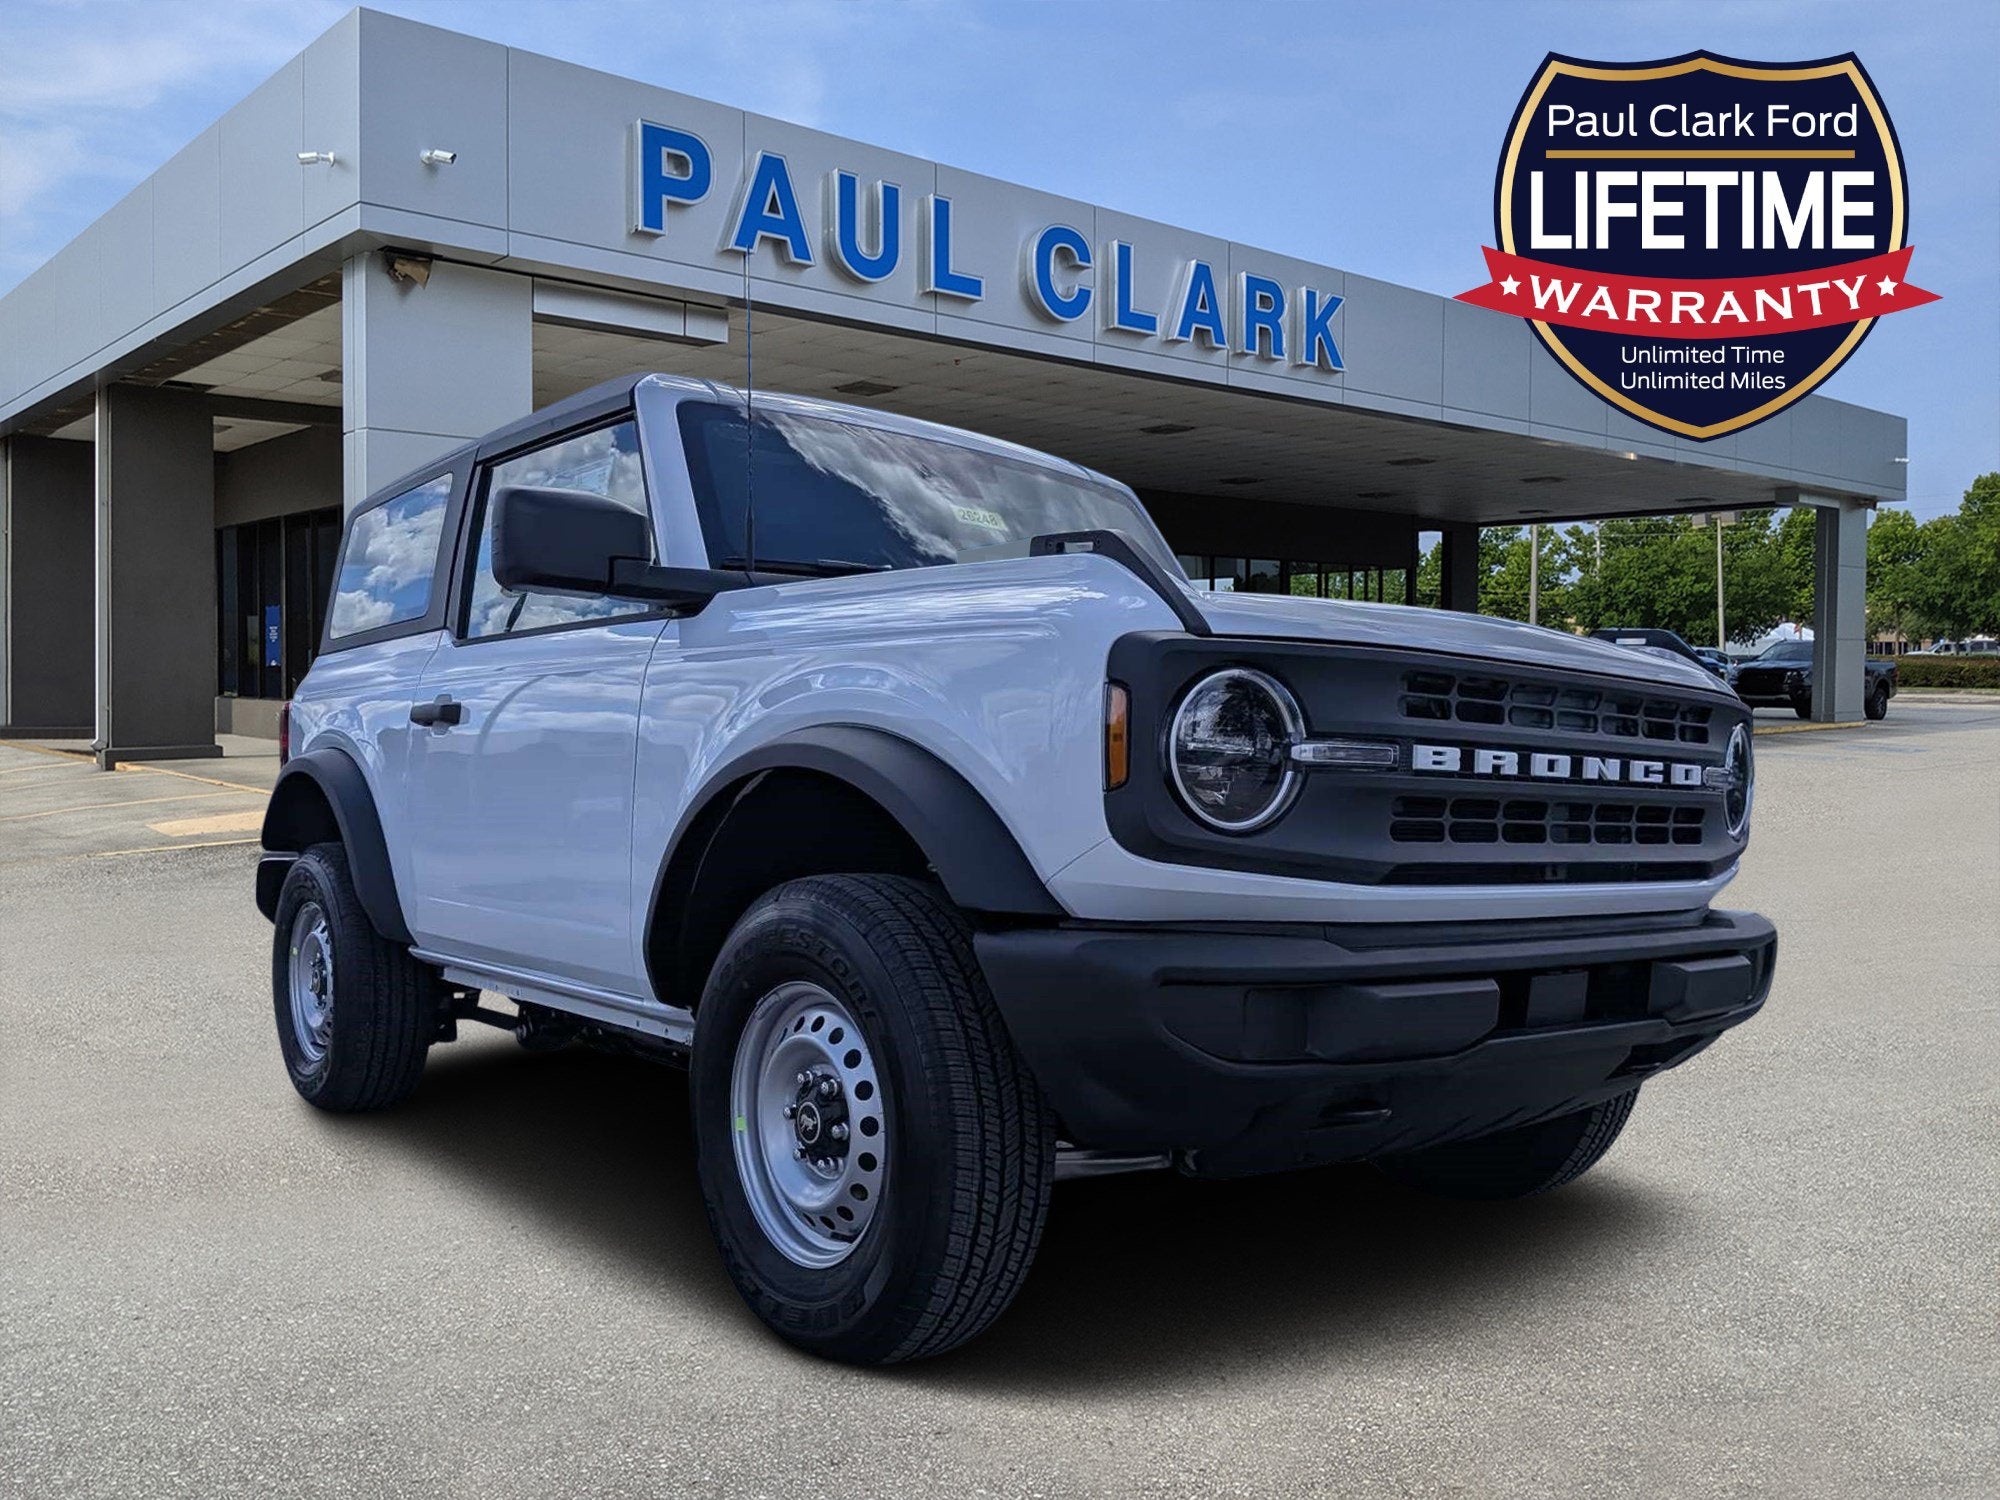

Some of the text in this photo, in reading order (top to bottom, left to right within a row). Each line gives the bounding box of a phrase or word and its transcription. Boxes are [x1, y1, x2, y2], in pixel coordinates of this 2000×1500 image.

[633, 119, 1347, 373] PAUL CLARK
[1412, 744, 1703, 787] BRONCO
